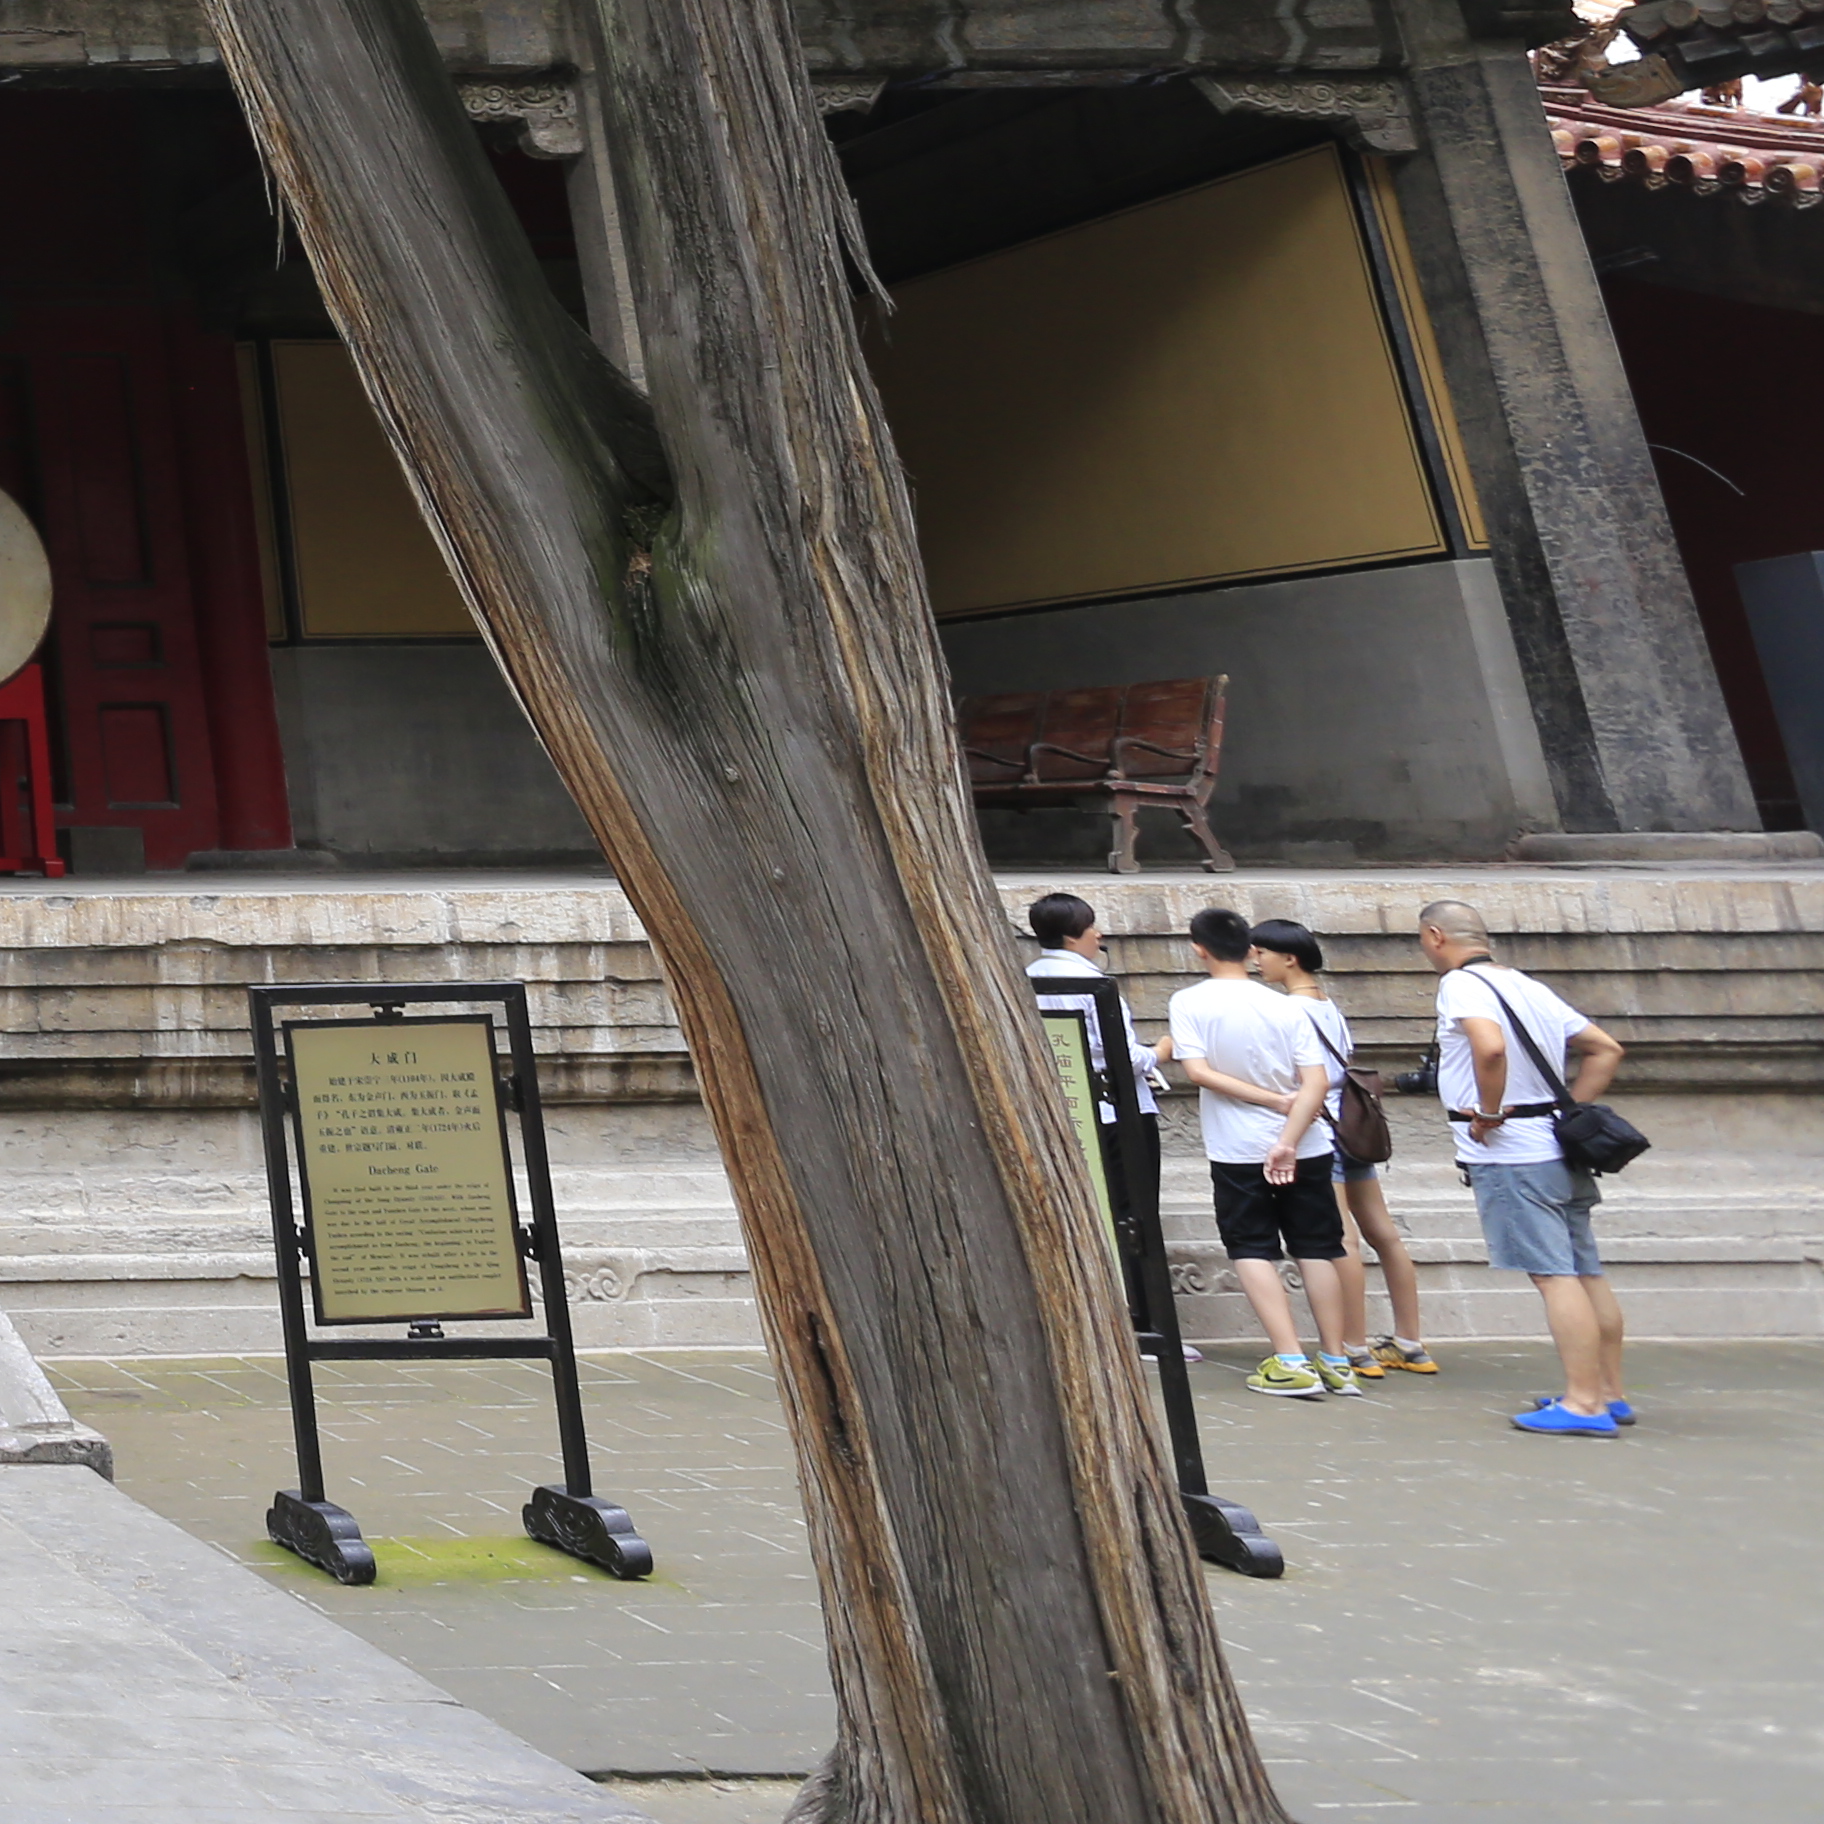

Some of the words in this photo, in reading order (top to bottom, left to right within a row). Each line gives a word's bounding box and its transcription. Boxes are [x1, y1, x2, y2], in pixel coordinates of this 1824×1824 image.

[370, 1051, 417, 1065] 大成门
[368, 1164, 410, 1176] Dacheng
[415, 1163, 439, 1174] Gate
